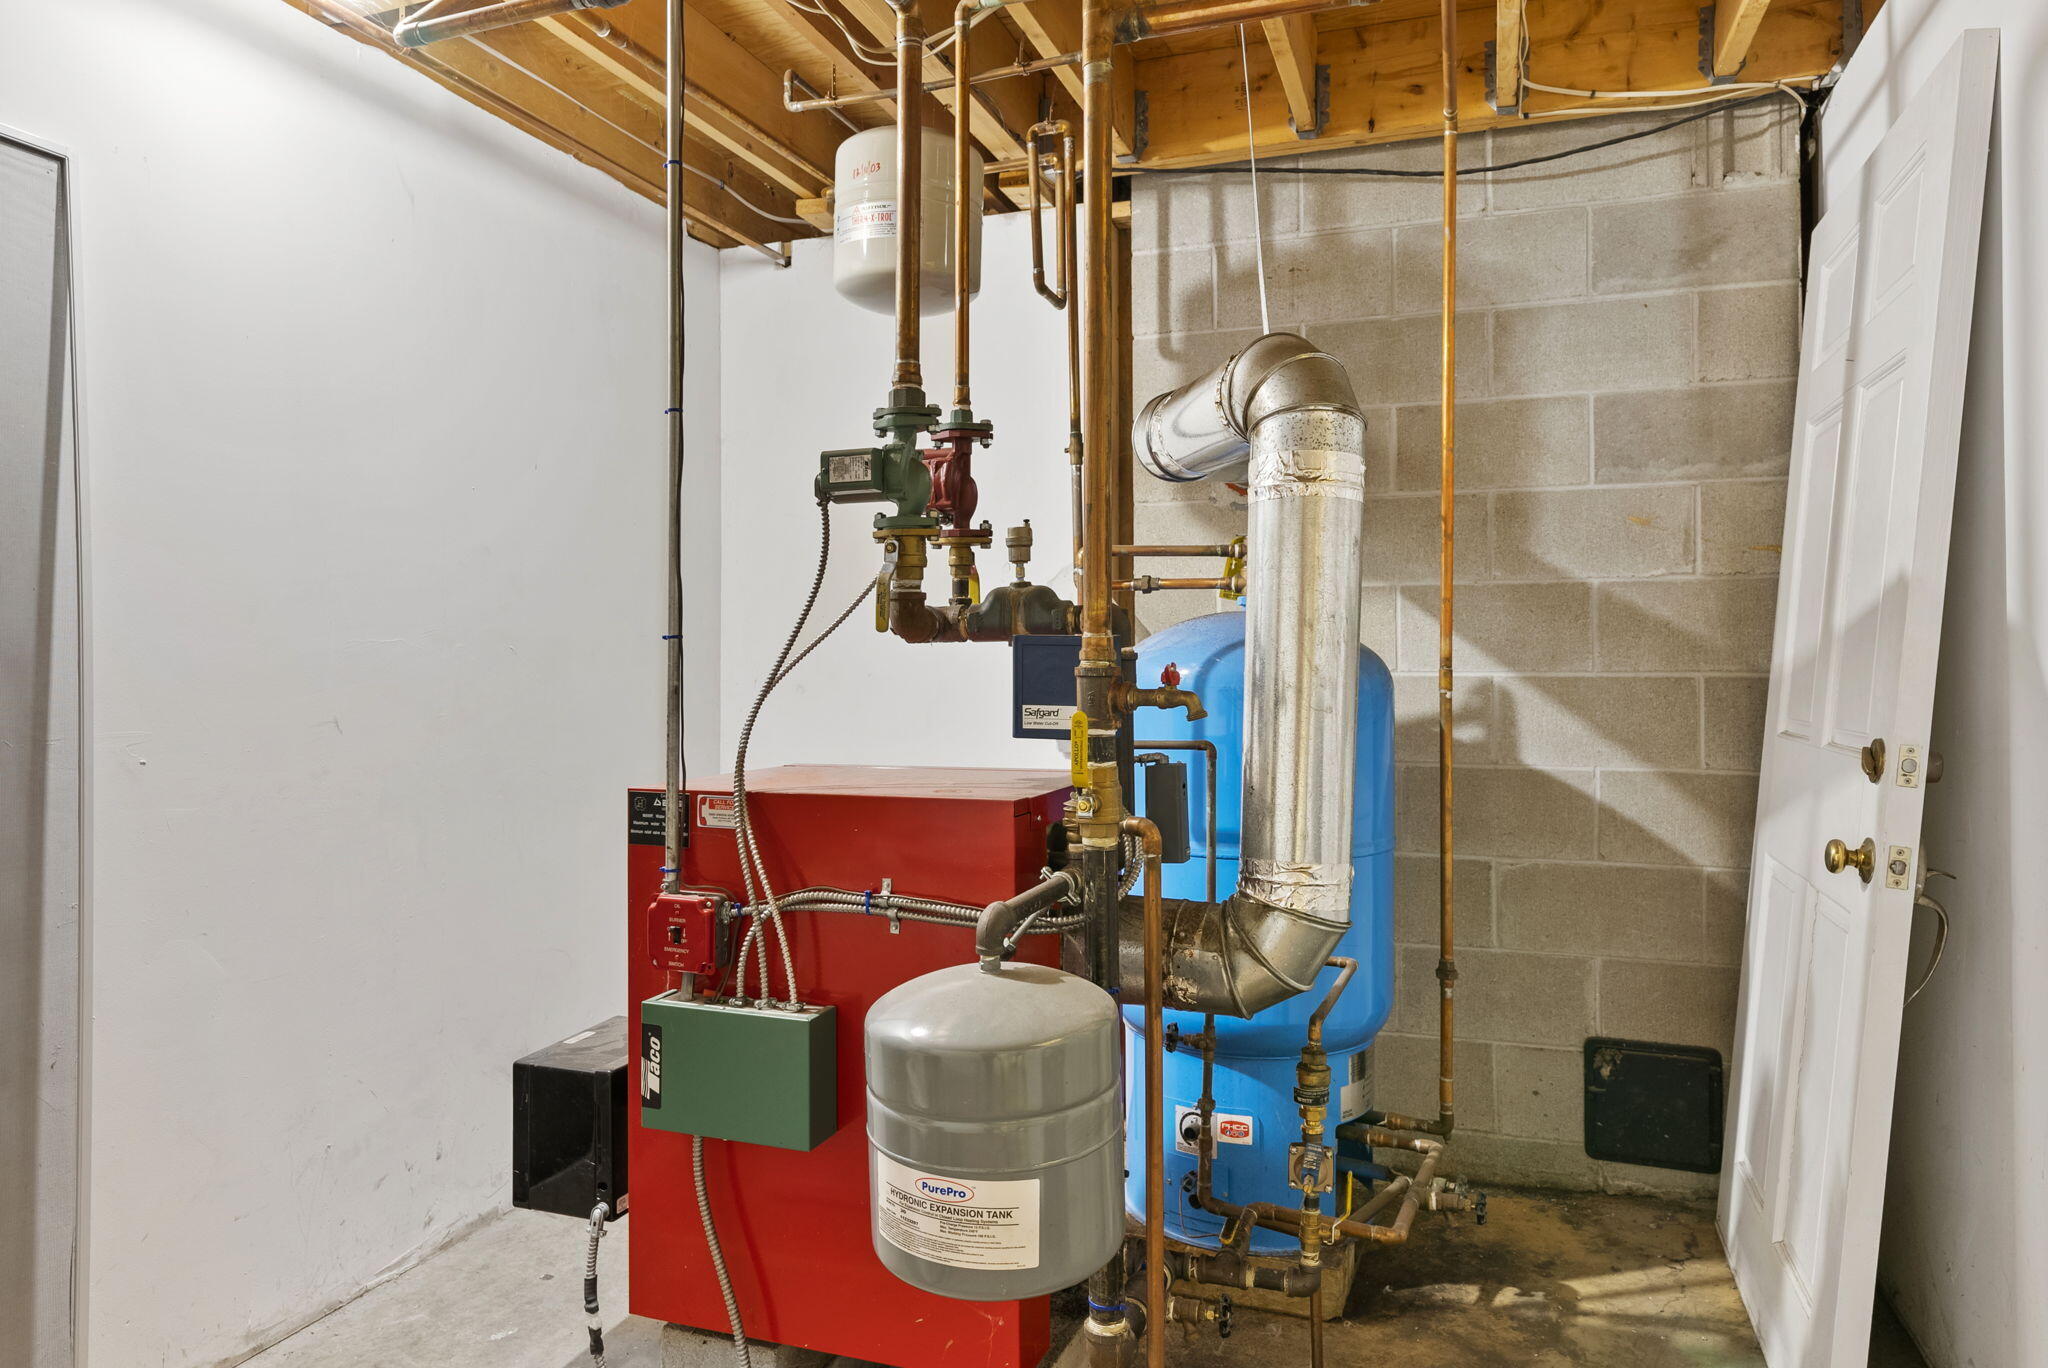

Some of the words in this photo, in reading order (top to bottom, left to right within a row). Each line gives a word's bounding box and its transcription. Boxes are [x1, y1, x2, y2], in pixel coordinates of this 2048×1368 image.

[1024, 707, 1060, 719] Safgard
[663, 946, 690, 954] EMERGENCY
[921, 1180, 967, 1199] PurePro
[890, 1186, 928, 1210] HYDRONIC
[929, 1203, 984, 1218] EXPANSION
[986, 1210, 1014, 1219] TANK
